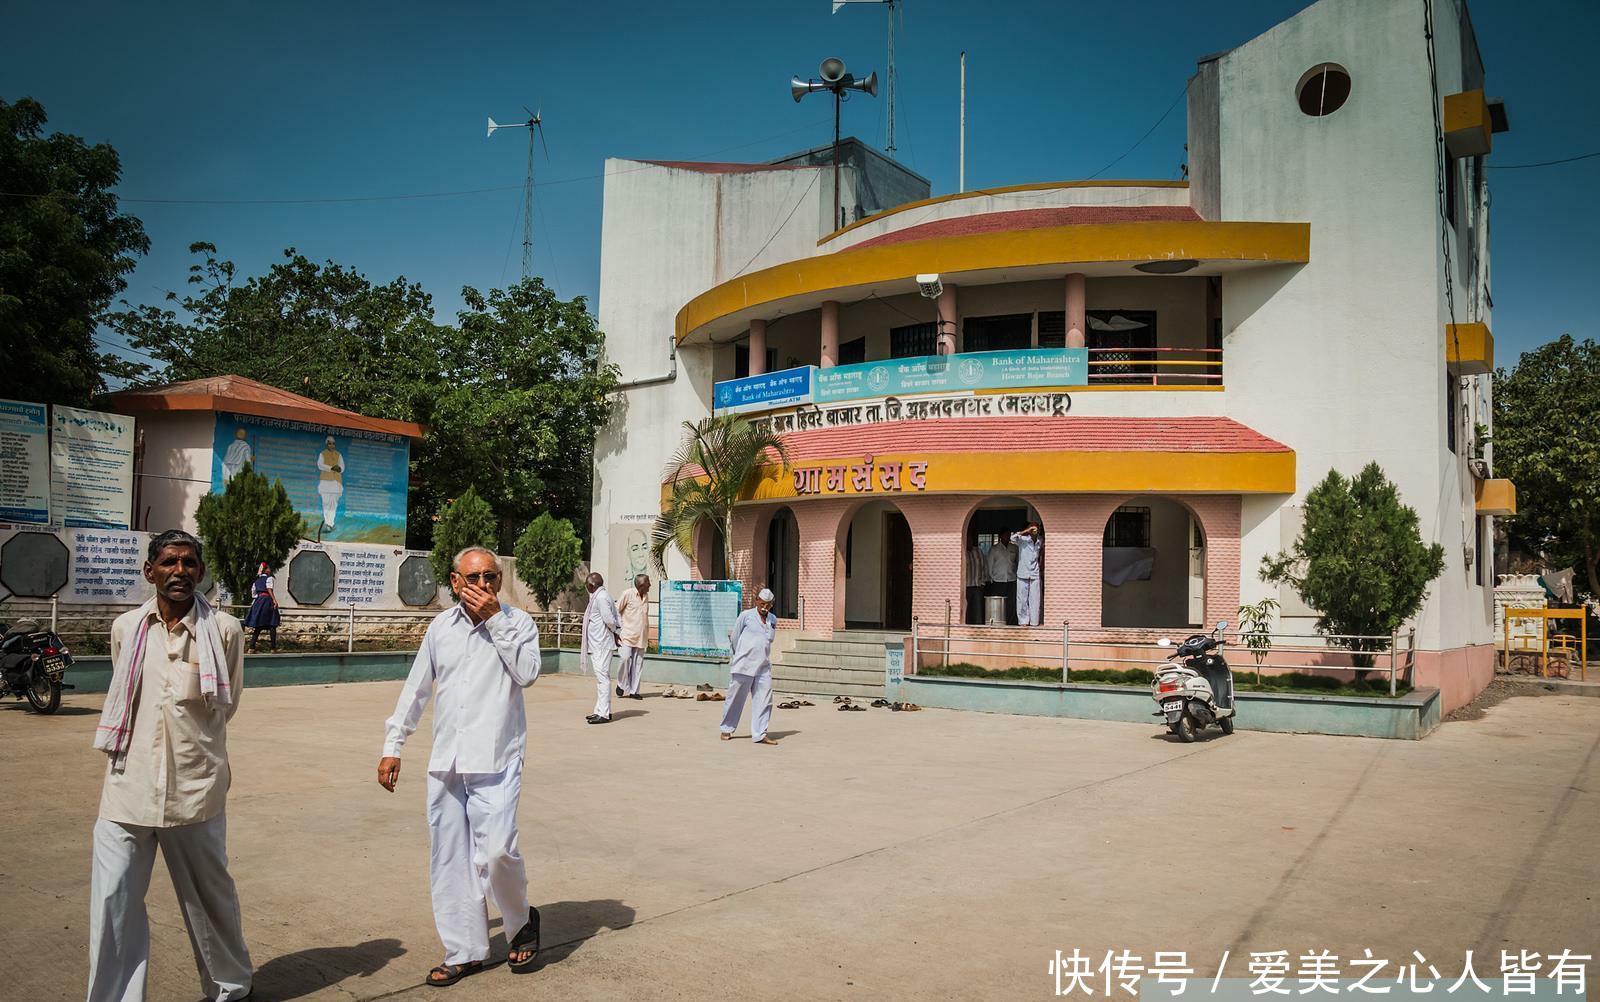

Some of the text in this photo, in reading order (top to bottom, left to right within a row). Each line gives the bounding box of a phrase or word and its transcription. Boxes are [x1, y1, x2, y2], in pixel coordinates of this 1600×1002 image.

[992, 355, 1080, 366] Bank of Maharashtra
[742, 393, 754, 401] Bank
[762, 388, 795, 398] Maharashtra
[796, 405, 824, 431] हिवरे
[826, 407, 861, 427] बाजार
